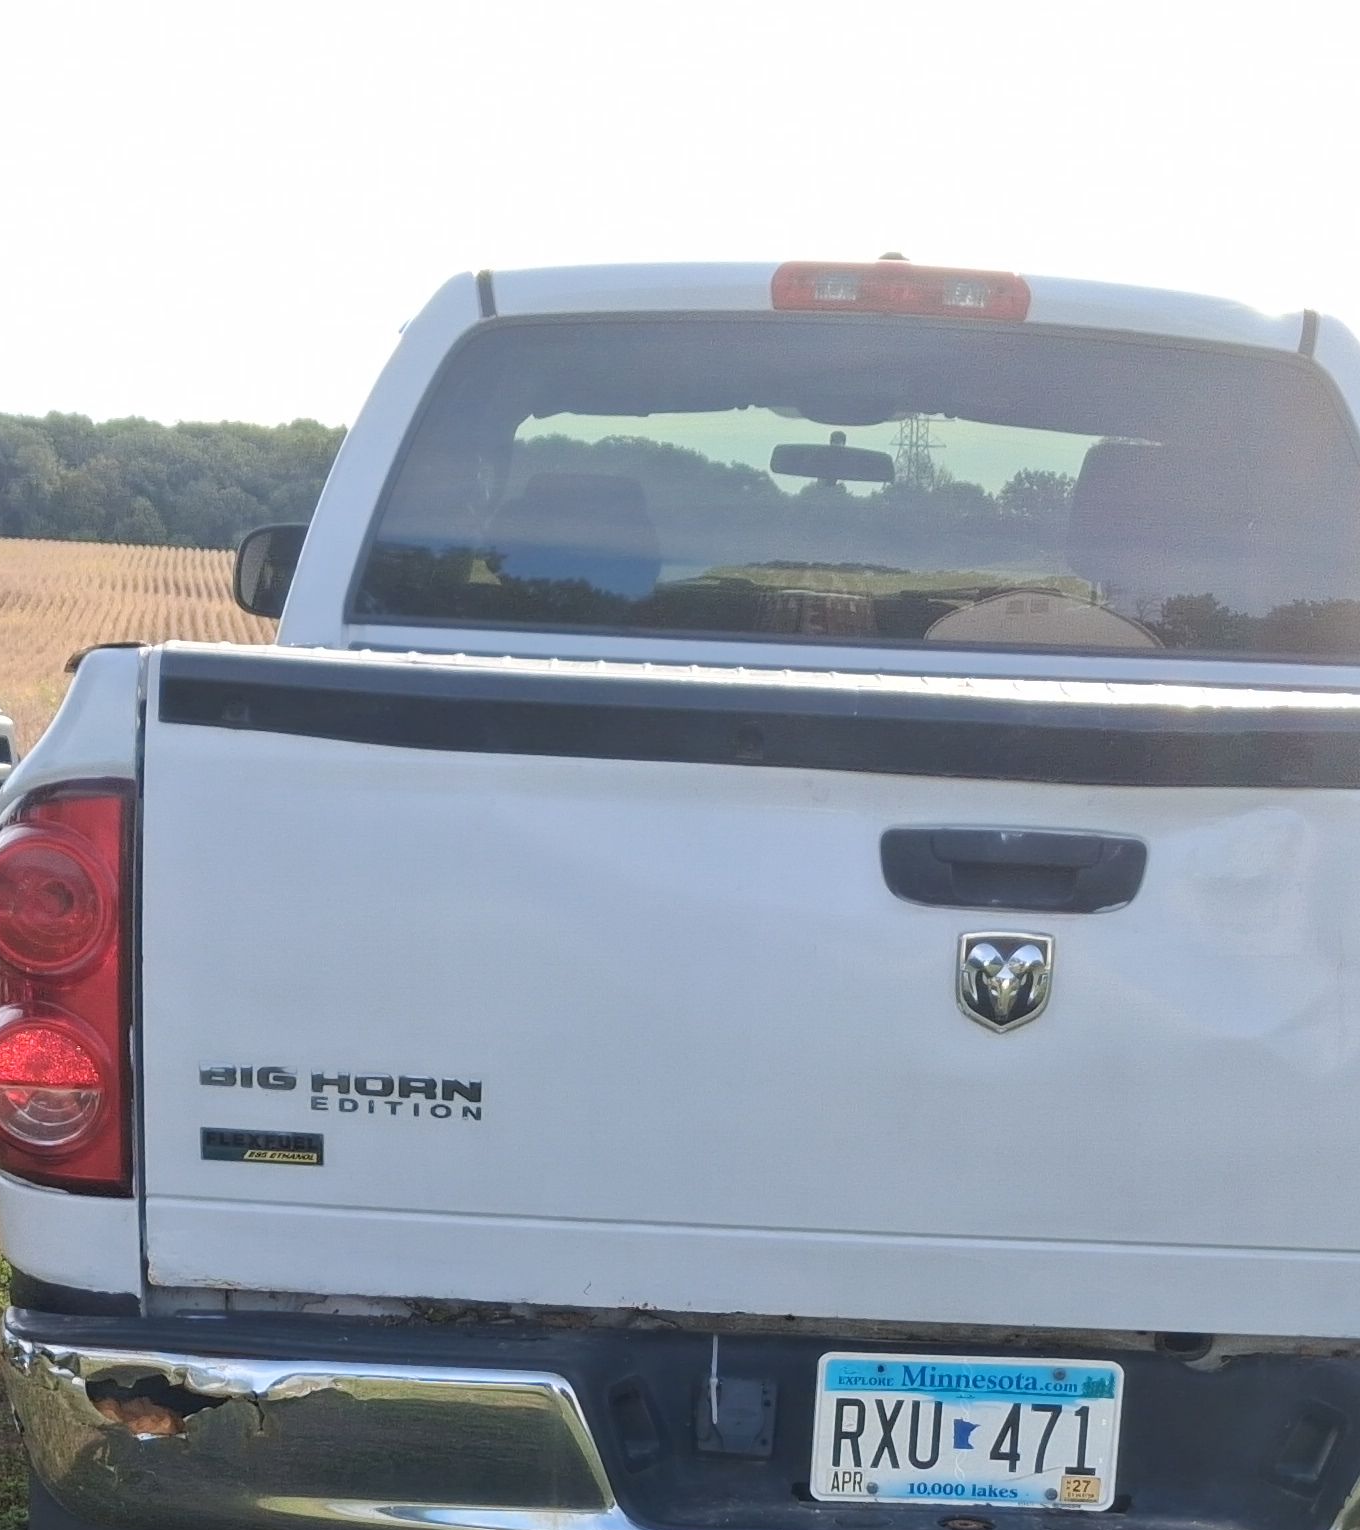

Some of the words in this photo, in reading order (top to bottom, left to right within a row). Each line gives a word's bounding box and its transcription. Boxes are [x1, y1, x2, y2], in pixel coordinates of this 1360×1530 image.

[199, 1064, 297, 1091] BIG
[311, 1070, 482, 1103] HORN
[310, 1096, 482, 1121] EDITION
[838, 1375, 894, 1387] EXPLORE
[831, 1397, 943, 1470] RXU
[990, 1402, 1096, 1476] 471
[830, 1471, 863, 1493] APR
[907, 1482, 965, 1497] 10,000
[971, 1483, 1018, 1499] lakes
[1072, 1479, 1092, 1493] 27
